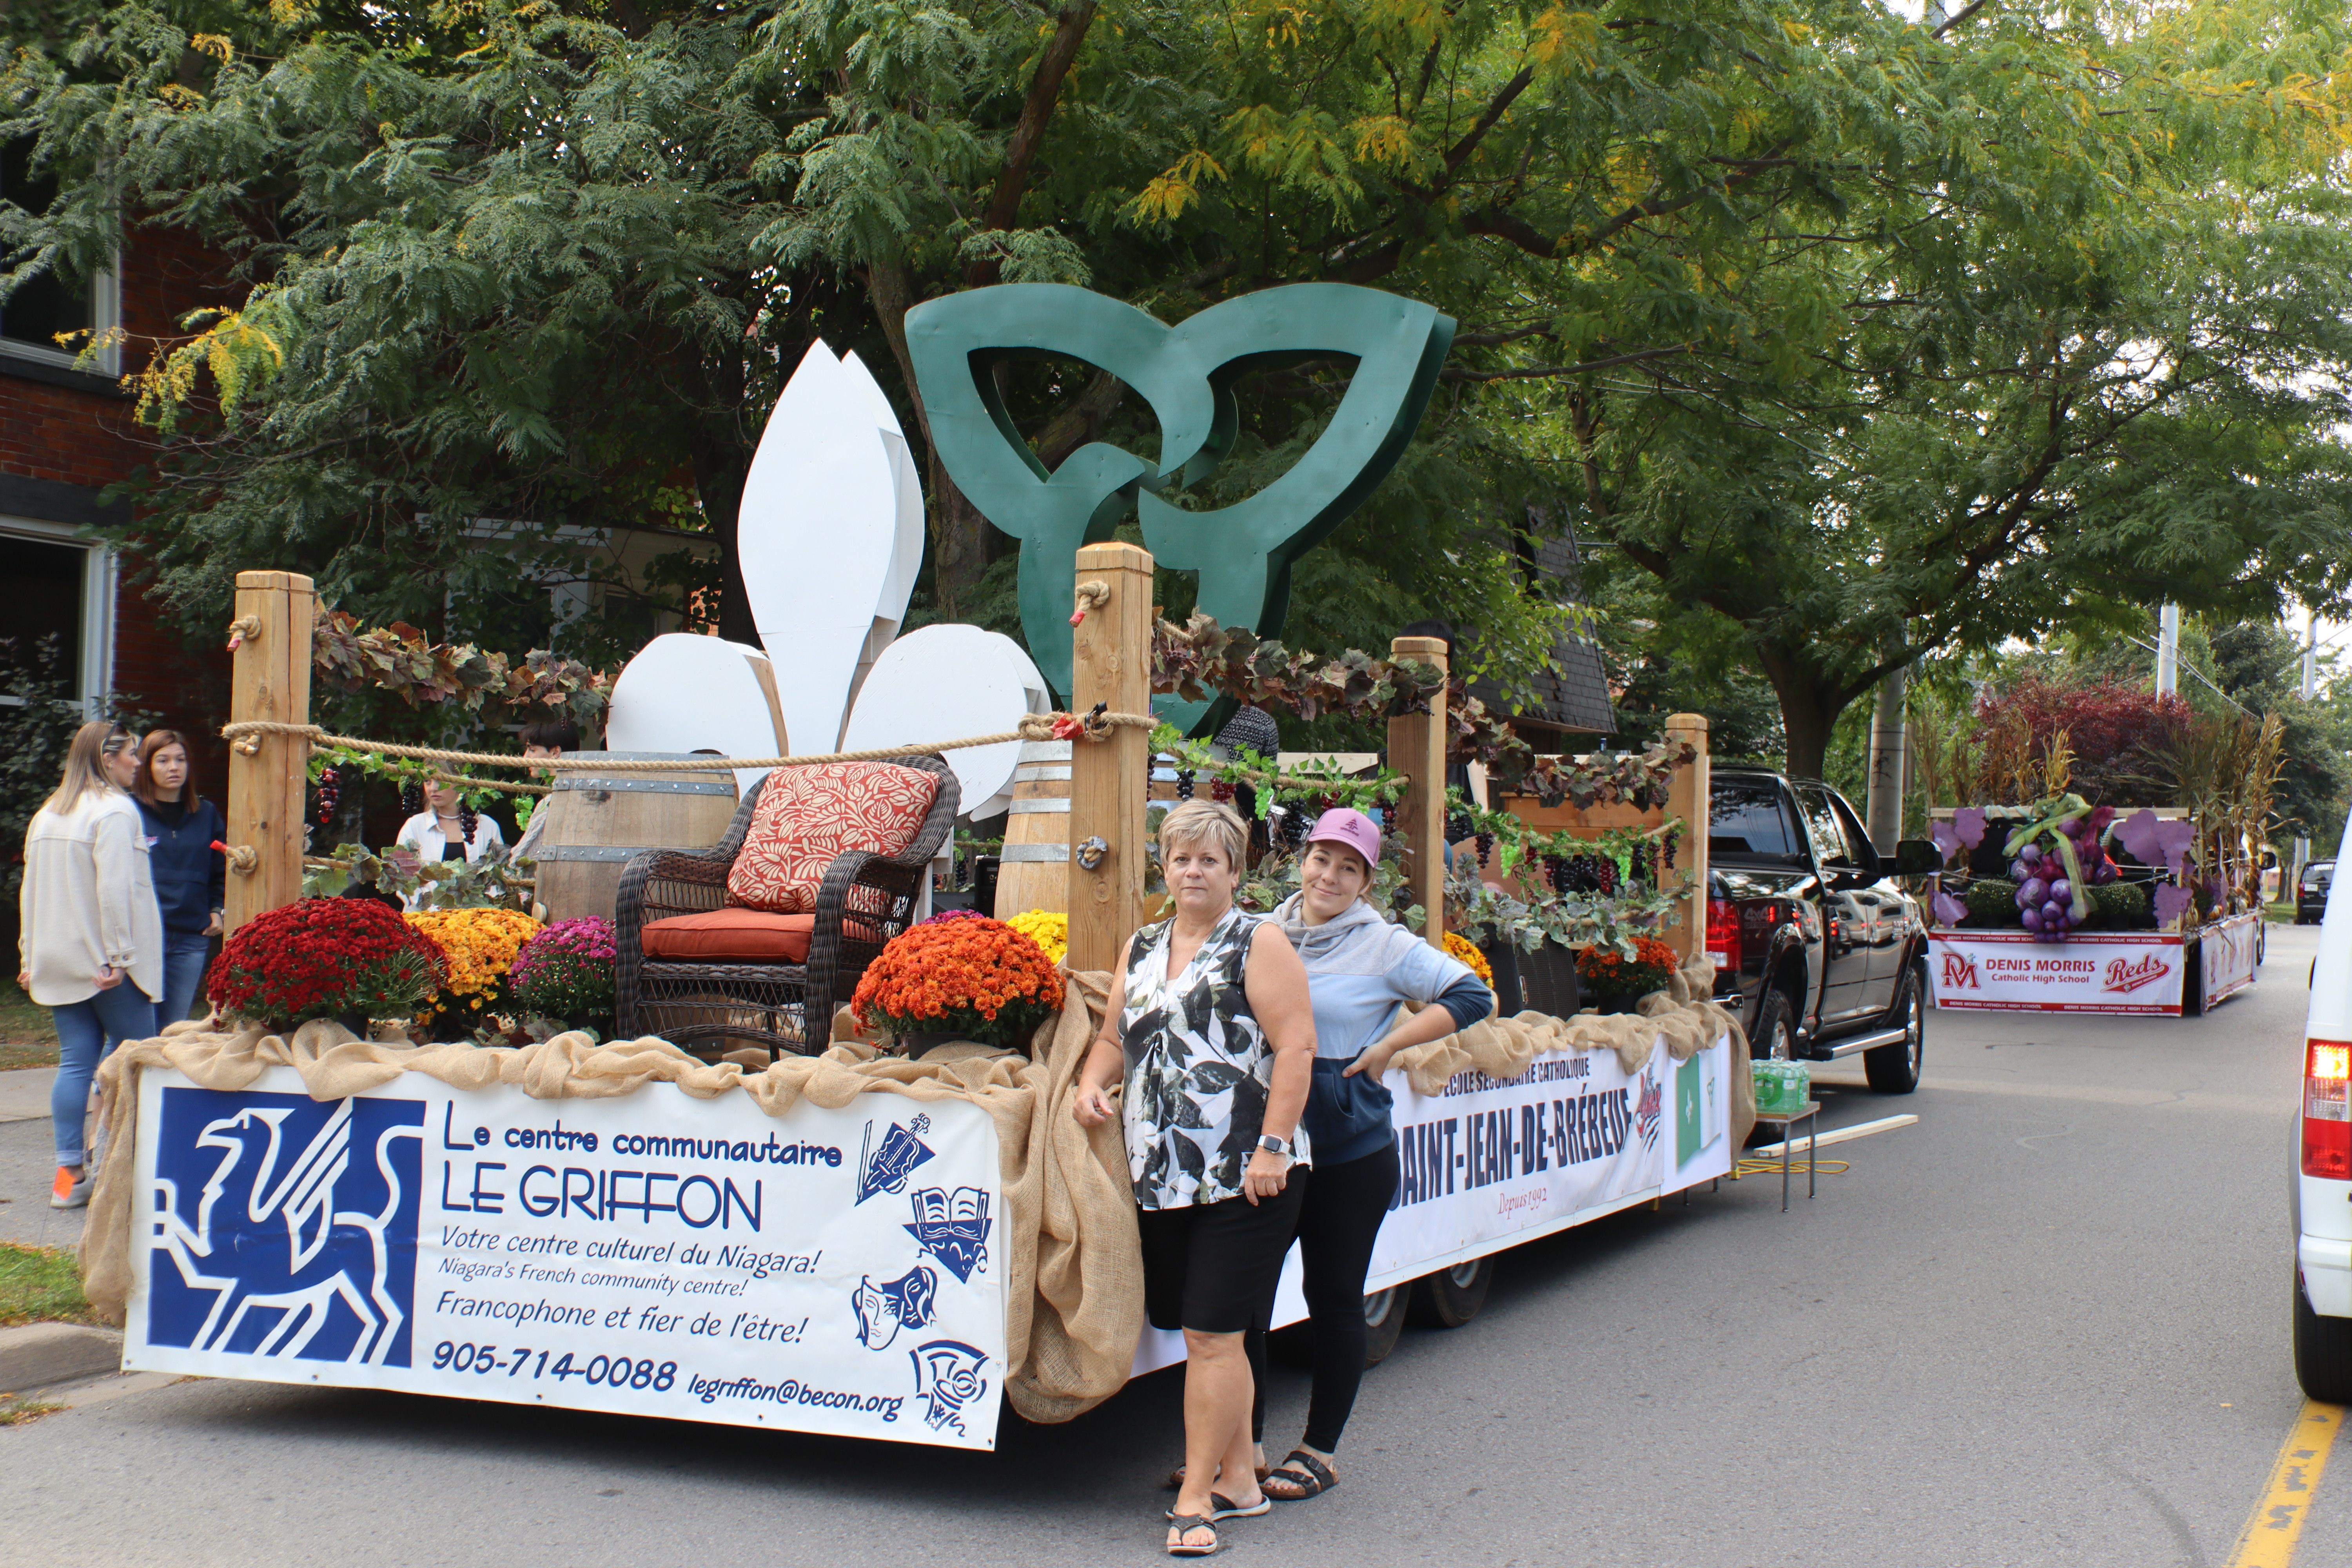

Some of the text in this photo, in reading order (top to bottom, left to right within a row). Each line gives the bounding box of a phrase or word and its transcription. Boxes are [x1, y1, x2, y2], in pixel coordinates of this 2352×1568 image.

[1985, 959, 2095, 972] DENIS MORRIS
[2033, 975, 2055, 984] High
[2058, 975, 2089, 983] School
[2103, 952, 2161, 986] Reds
[1538, 1057, 1590, 1083] CATHOLIQUE
[444, 1100, 842, 1168] Le centre communautaire
[441, 1160, 762, 1233] LE GRIFFON
[1497, 1187, 1547, 1220] Depuis 1992
[442, 1226, 822, 1279] Votre centre culturel du Niagara!
[438, 1258, 748, 1297] Niagara's French community centre!
[436, 1291, 809, 1343] Francophone et fier de l'être!
[432, 1341, 904, 1423] 905-714-0088 legriffon@becon.org
